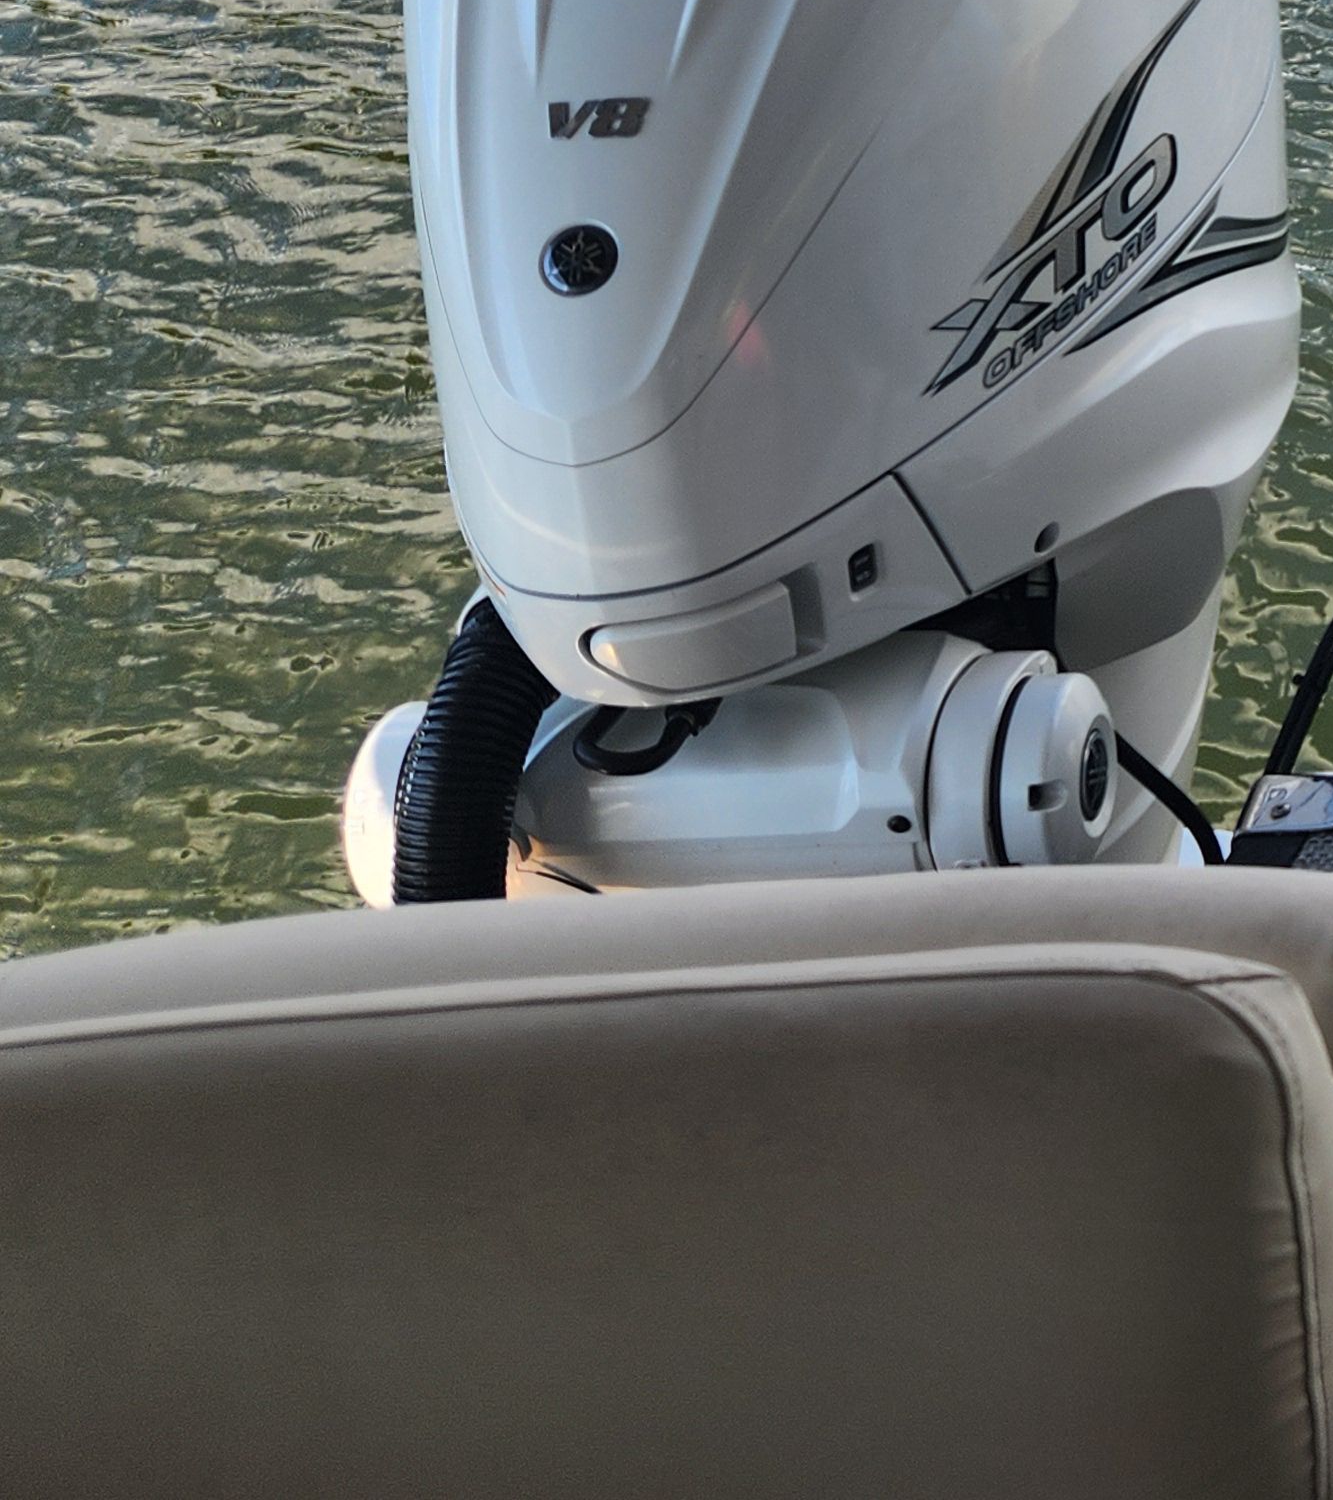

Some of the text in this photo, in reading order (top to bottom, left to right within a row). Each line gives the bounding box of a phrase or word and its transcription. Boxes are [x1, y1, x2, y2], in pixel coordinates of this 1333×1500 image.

[548, 97, 653, 139] V8
[920, 132, 1178, 398] XTO
[982, 212, 1158, 389] OFFSHORE
